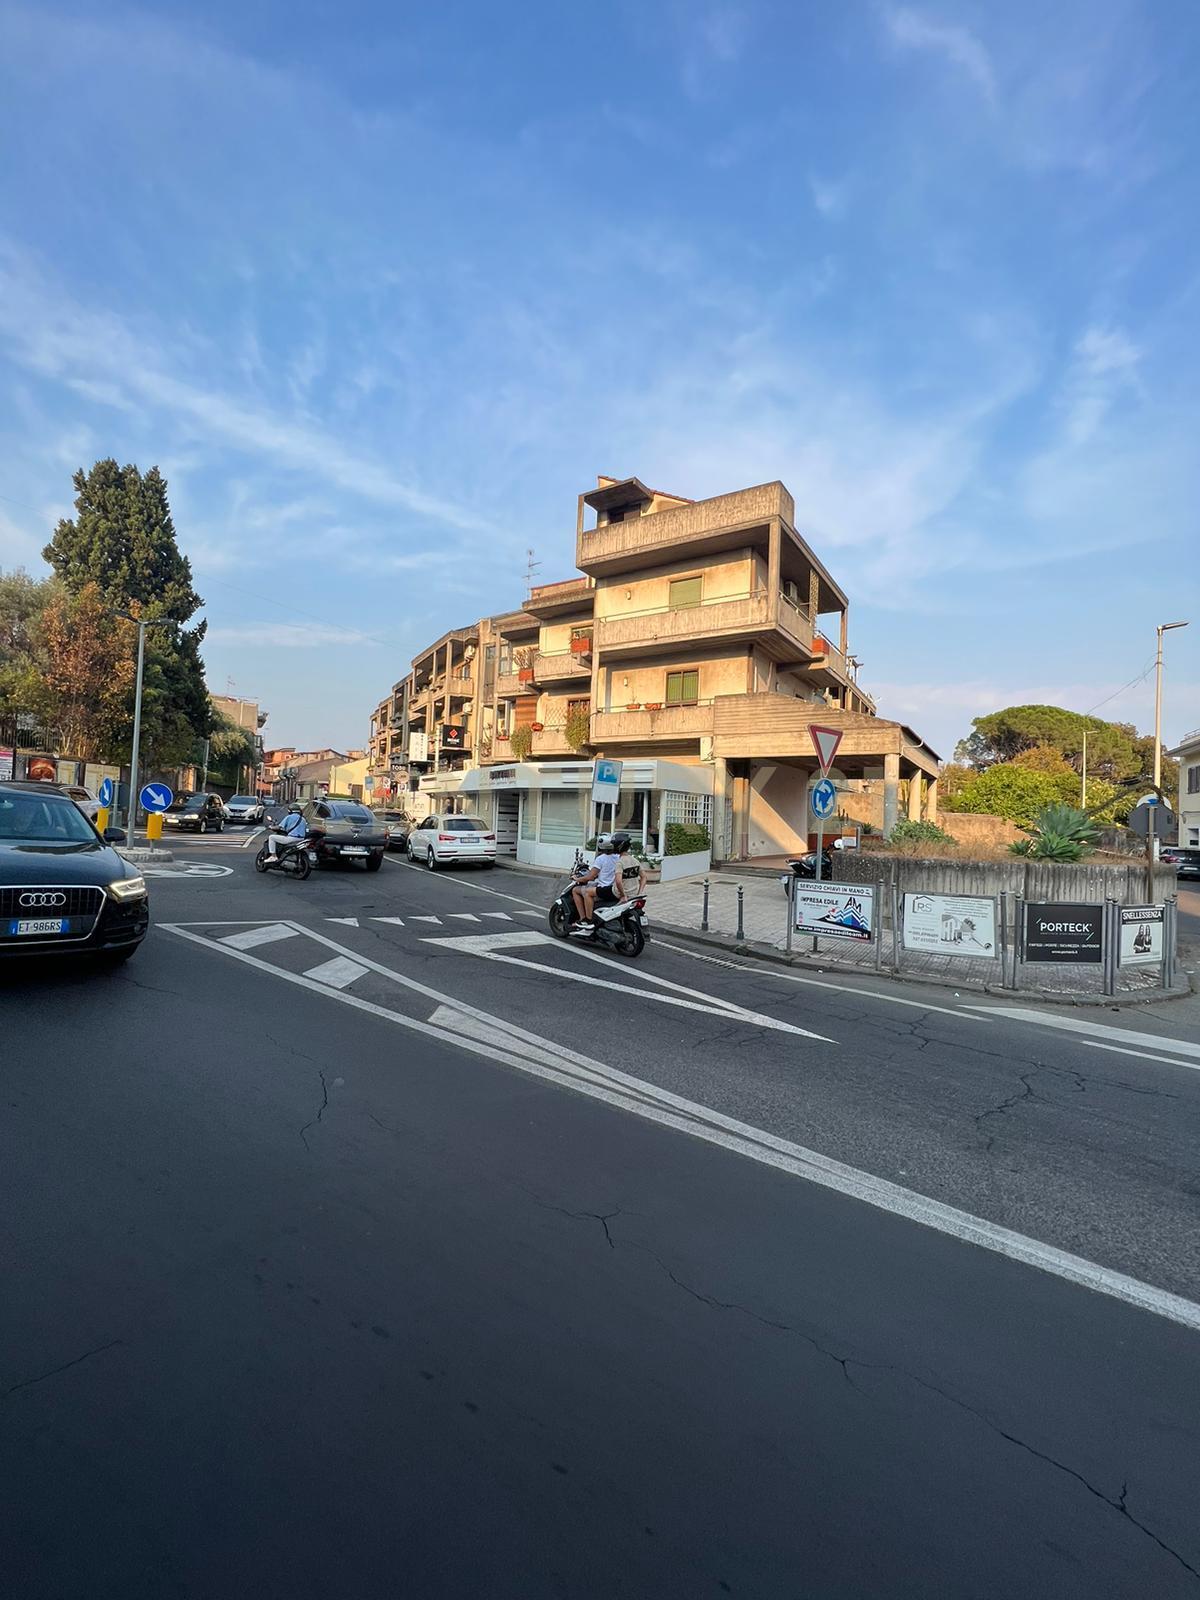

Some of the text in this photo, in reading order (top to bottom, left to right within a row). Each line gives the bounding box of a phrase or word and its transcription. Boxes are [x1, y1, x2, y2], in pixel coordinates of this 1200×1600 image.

[603, 768, 613, 779] P
[800, 883, 822, 891] SERVIZIO
[823, 885, 841, 893] CHIAVI
[801, 896, 822, 904] IMPRESA
[823, 898, 839, 906] EDILE
[1123, 911, 1161, 920] SNELLESSENZA
[19, 922, 61, 932] ET 986RS
[1040, 922, 1089, 932] PORTECK
